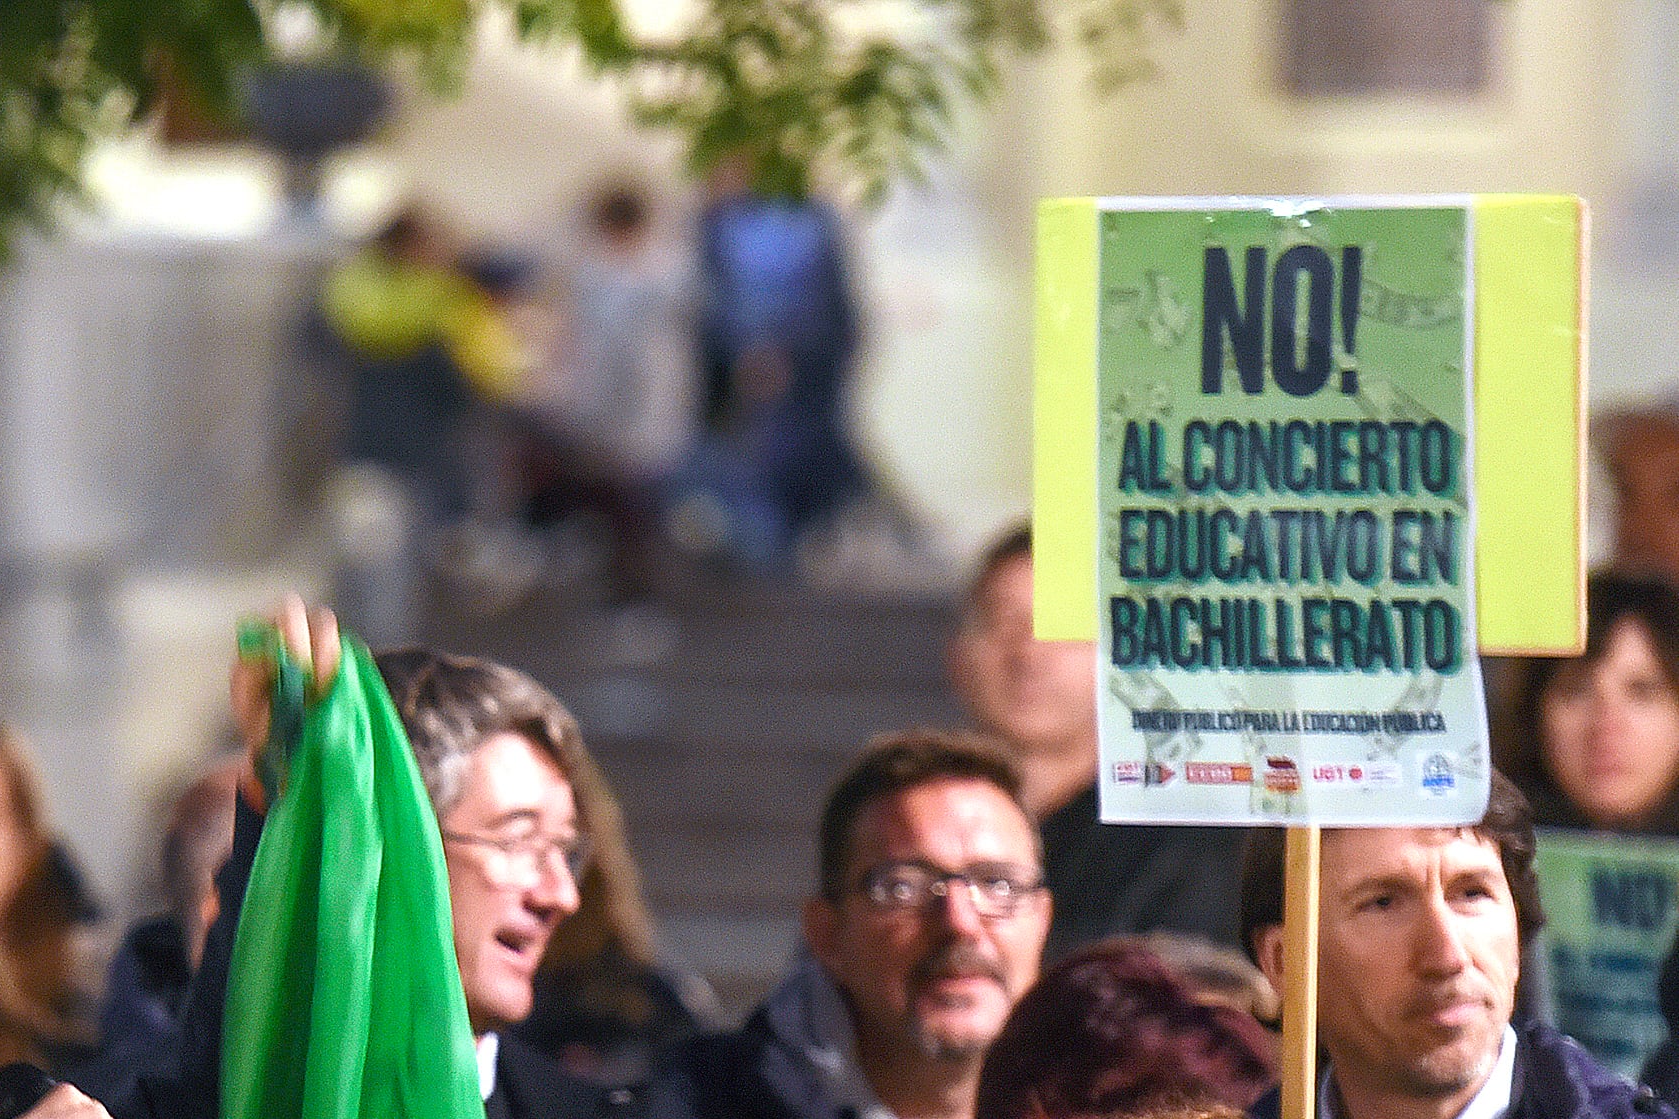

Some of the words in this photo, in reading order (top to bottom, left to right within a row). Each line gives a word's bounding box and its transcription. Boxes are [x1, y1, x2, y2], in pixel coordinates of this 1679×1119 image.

[1201, 244, 1363, 398] NO!
[1118, 420, 1173, 496] AL
[1182, 419, 1460, 495] CONCIERTO
[1118, 508, 1384, 586] EDUCATIVO
[1391, 508, 1461, 587] EN
[1110, 597, 1463, 676] BACHILLERATO
